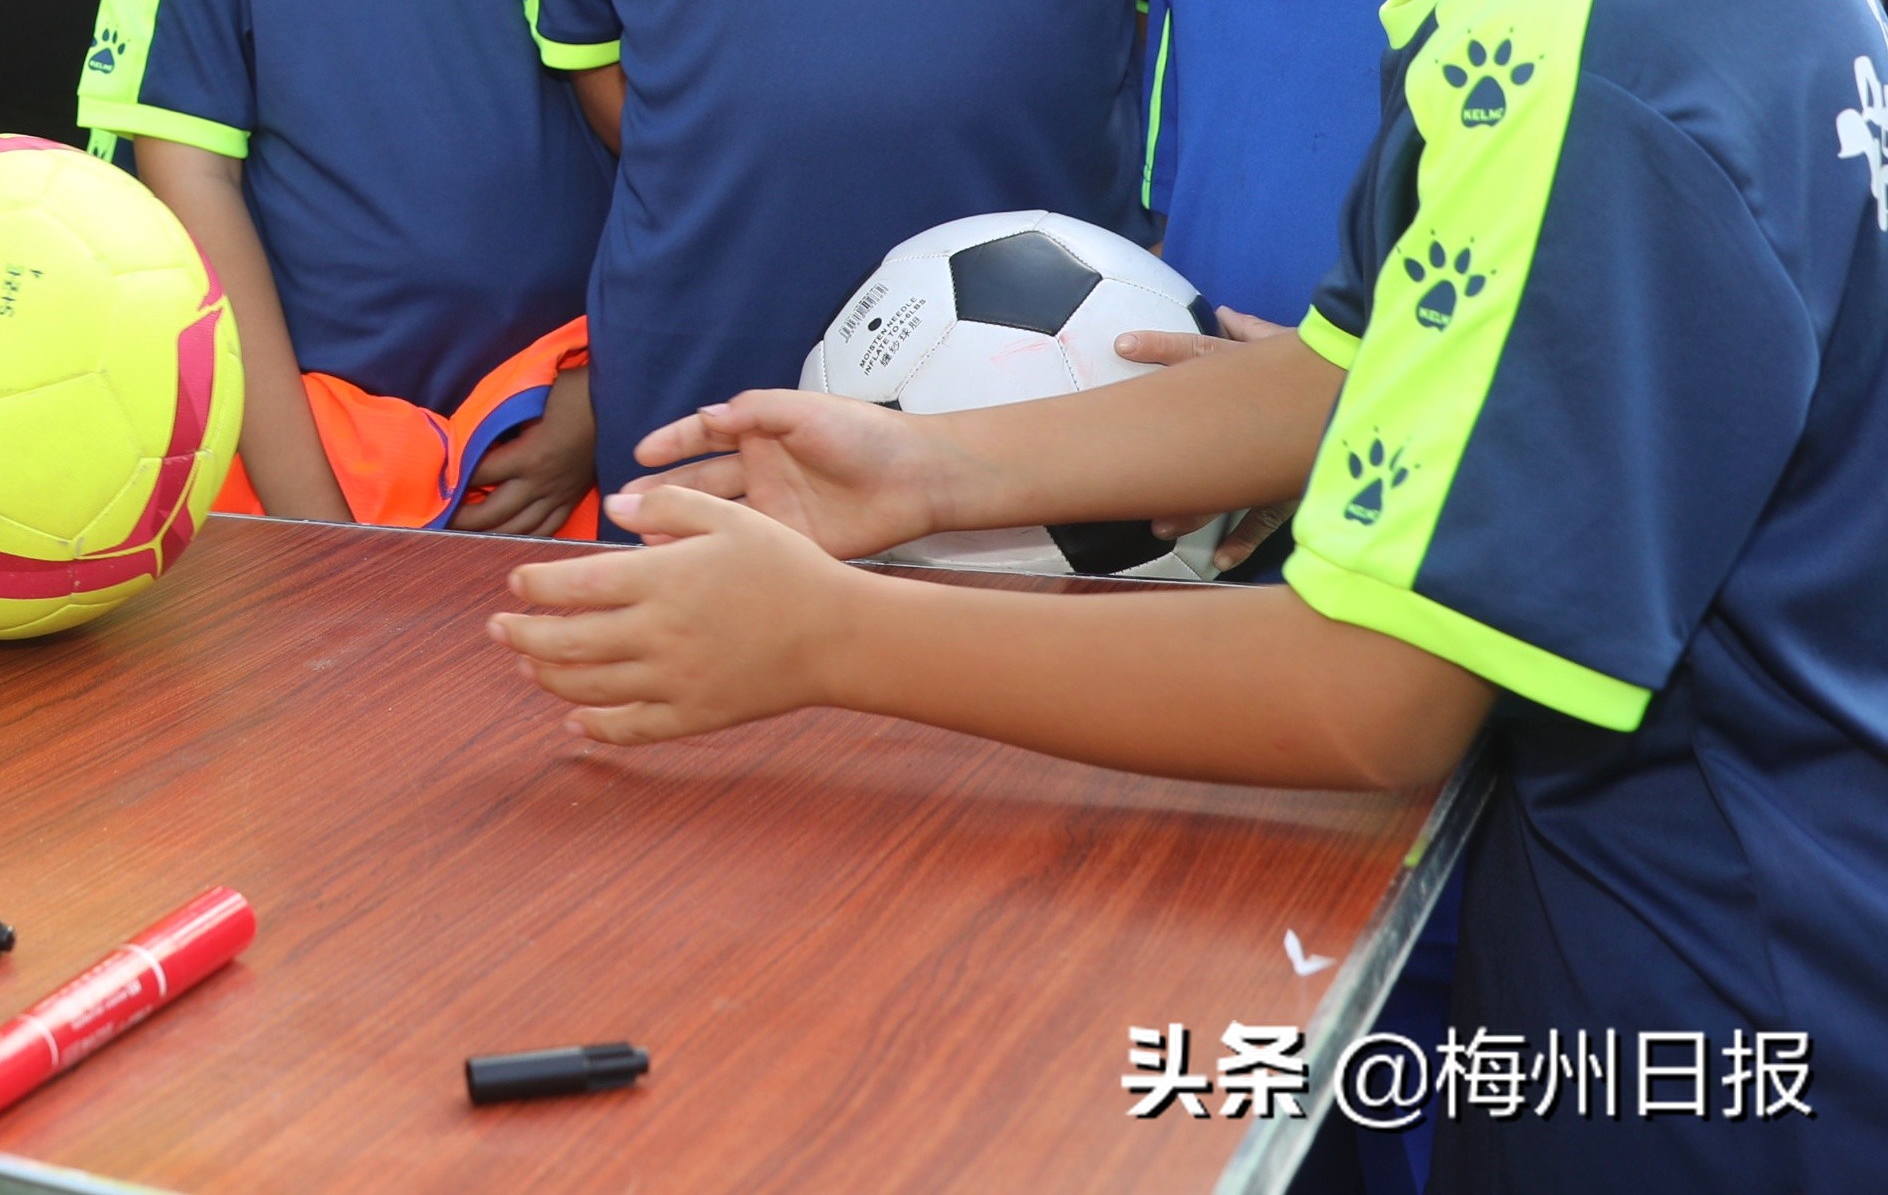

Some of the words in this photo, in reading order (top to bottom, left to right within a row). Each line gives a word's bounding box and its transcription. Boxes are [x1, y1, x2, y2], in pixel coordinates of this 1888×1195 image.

[859, 327, 888, 368] MOISTEN
[886, 296, 918, 328] NEEDLE
[863, 338, 890, 376] INFLATE
[888, 325, 900, 337] TO
[899, 298, 927, 325] 4-6LBS
